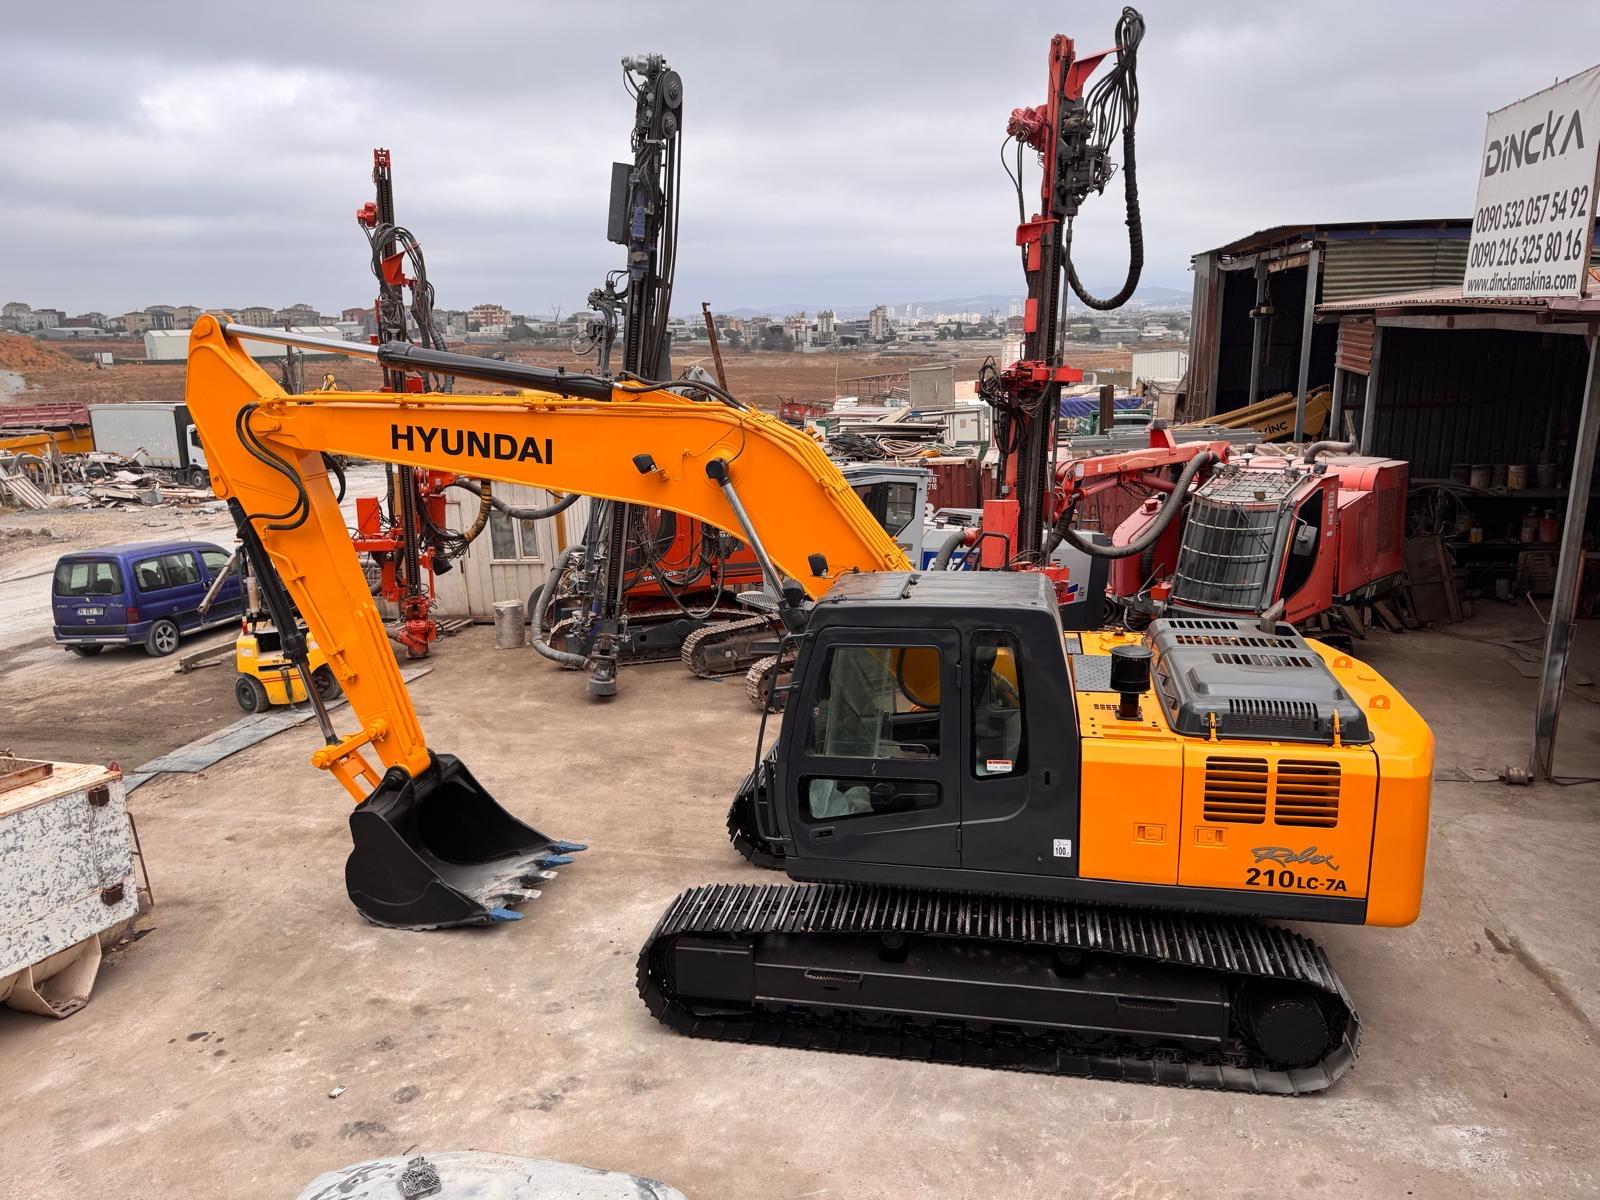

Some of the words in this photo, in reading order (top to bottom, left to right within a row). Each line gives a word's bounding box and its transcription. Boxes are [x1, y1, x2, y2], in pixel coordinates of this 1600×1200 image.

[1476, 204, 1502, 233] 0090
[1503, 199, 1524, 230] 532
[1525, 194, 1550, 226] 057
[1550, 189, 1569, 222] 54
[1570, 185, 1588, 219] 92
[1470, 240, 1496, 268] 0090
[1497, 236, 1518, 267] 216
[1519, 234, 1543, 264] 325
[1544, 231, 1562, 263] 80
[1564, 228, 1582, 261] 16
[1467, 271, 1577, 292] www.dinckamakina.com
[391, 424, 552, 465] HYUNDAI
[1055, 846, 1066, 856] 100
